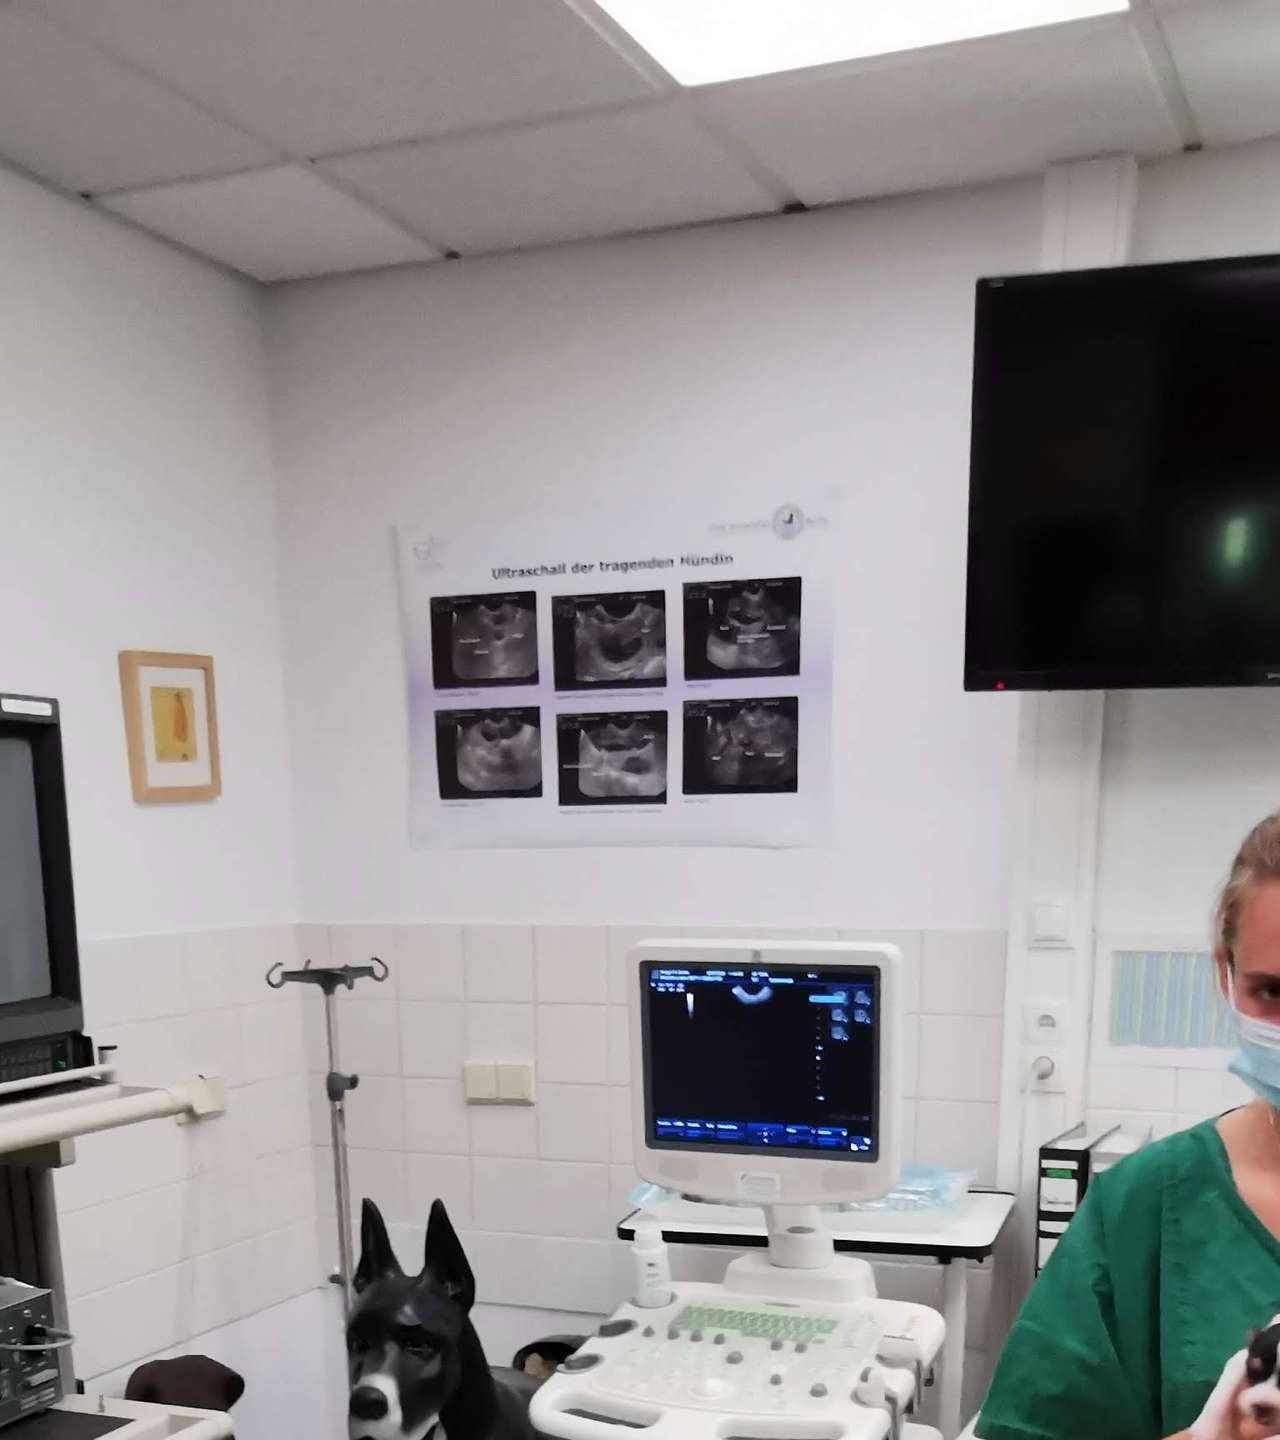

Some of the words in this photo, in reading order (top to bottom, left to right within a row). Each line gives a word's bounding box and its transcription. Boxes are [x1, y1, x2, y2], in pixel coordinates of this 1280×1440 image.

[571, 561, 595, 574] der
[599, 556, 674, 575] tragenden
[680, 553, 734, 567] Hündin
